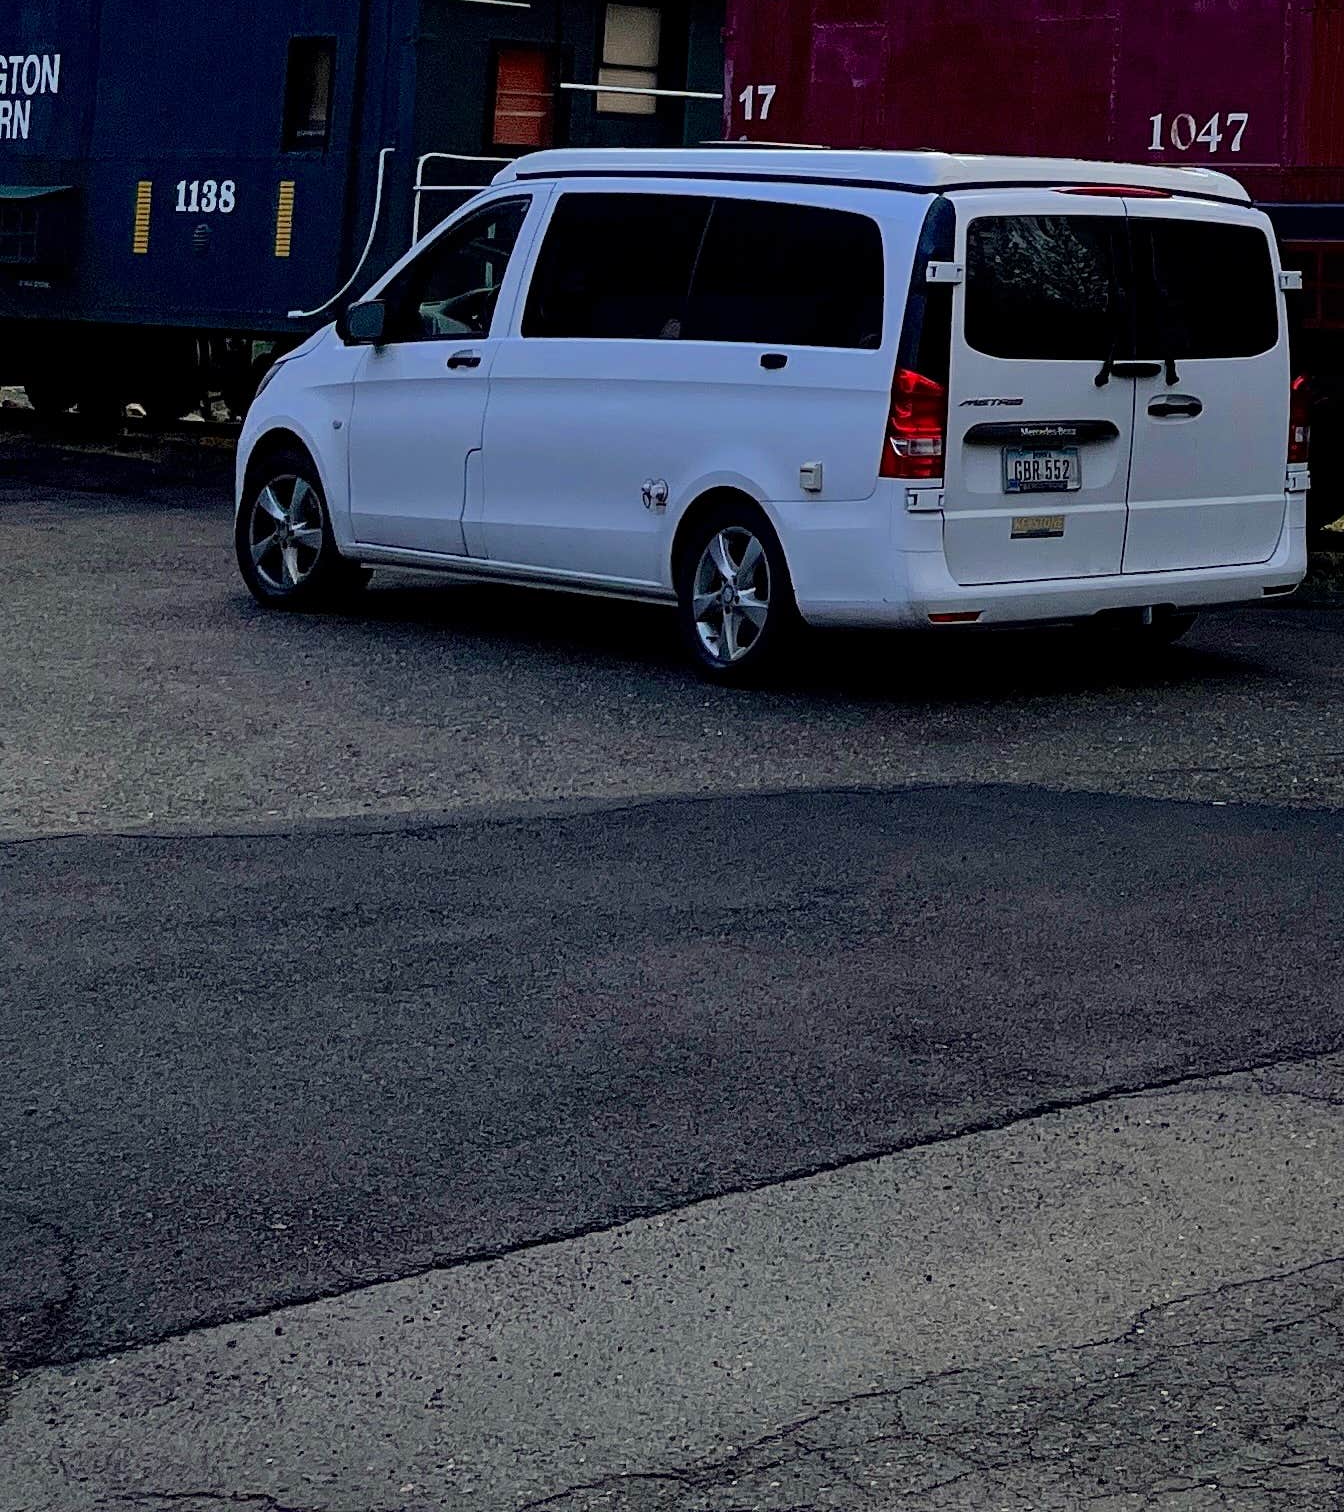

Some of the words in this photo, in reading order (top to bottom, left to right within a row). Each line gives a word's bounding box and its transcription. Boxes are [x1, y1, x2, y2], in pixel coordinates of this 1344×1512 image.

[739, 85, 776, 120] 17
[1147, 112, 1249, 153] 1047
[175, 179, 236, 213] 1138
[1020, 427, 1077, 437] Mercedes-Benz
[1014, 462, 1040, 482] GBR
[1045, 460, 1070, 480] 552
